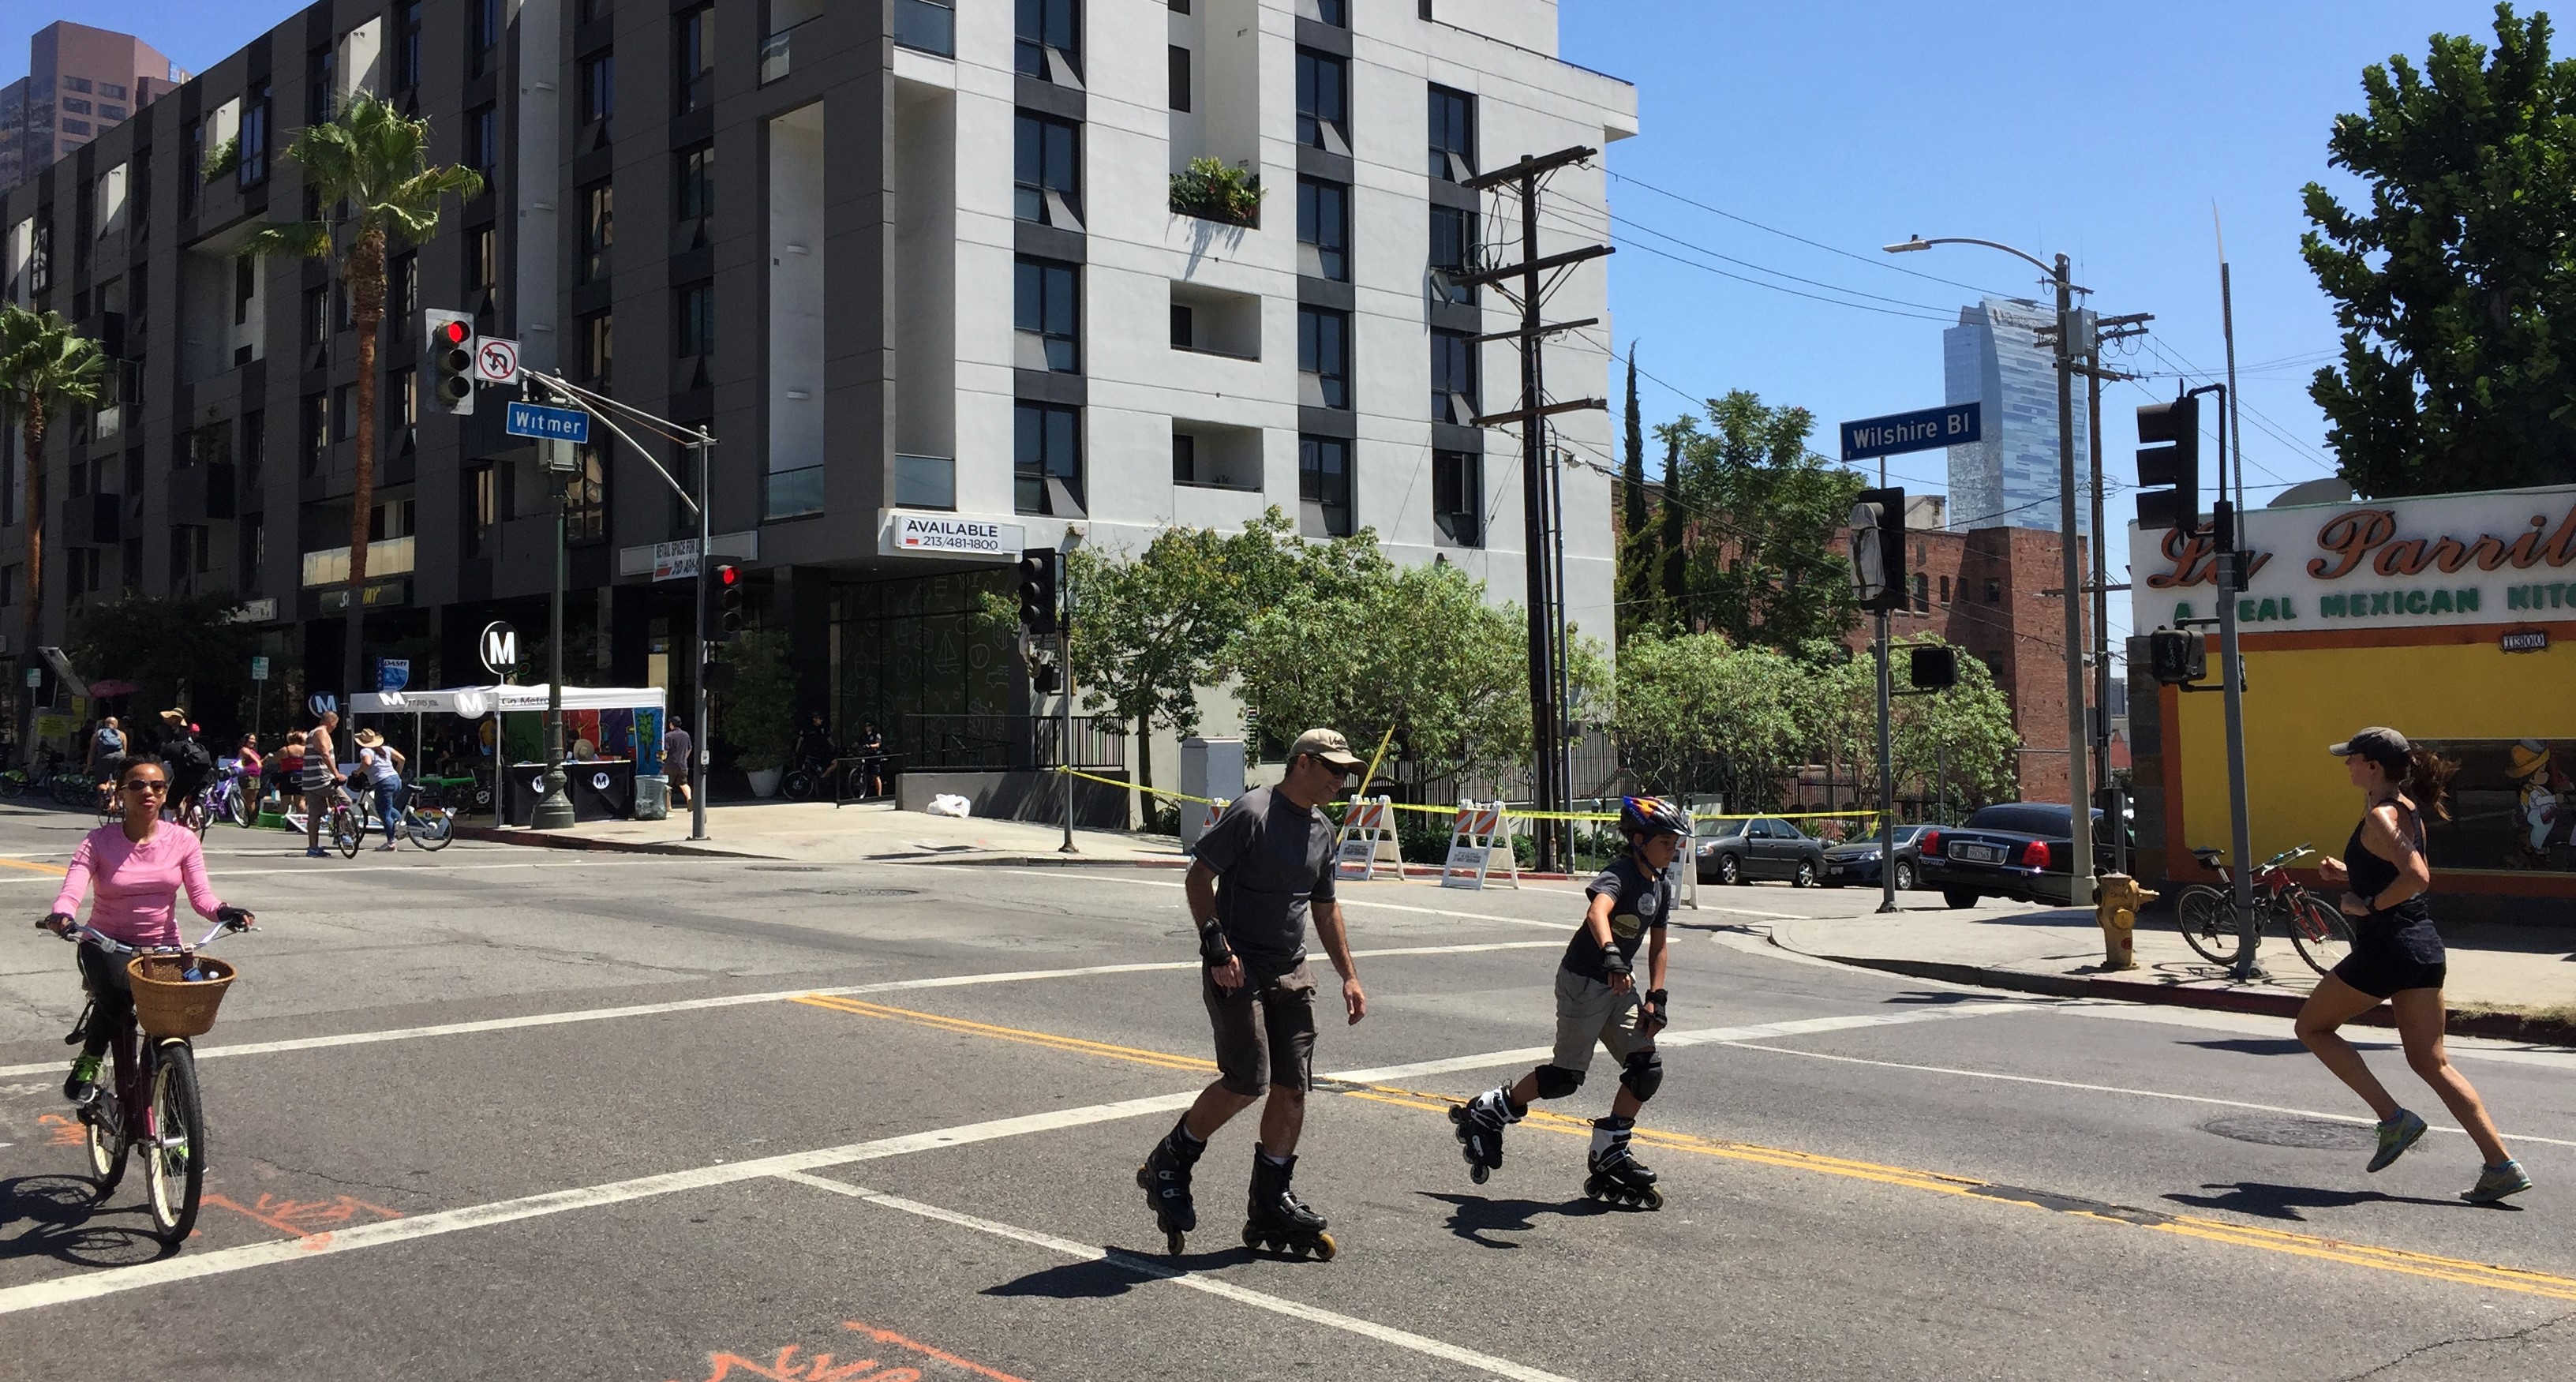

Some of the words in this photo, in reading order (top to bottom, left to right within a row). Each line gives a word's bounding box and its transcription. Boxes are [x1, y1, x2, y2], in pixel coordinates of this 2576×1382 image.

[515, 410, 582, 435] Witmer
[1853, 421, 1938, 449] Wilshire
[1947, 412, 1969, 435] Bl
[906, 520, 998, 538] AVAILABLE
[923, 535, 998, 550] 213/481-1800
[339, 586, 381, 607] SAY
[2216, 597, 2297, 622] EAL
[2321, 587, 2479, 618] MEXICAN
[489, 631, 515, 665] M
[2504, 633, 2545, 649] 1300
[314, 695, 338, 713] M
[378, 691, 406, 706] M
[458, 692, 484, 712] M
[519, 695, 550, 705] Metro
[596, 775, 607, 785] M
